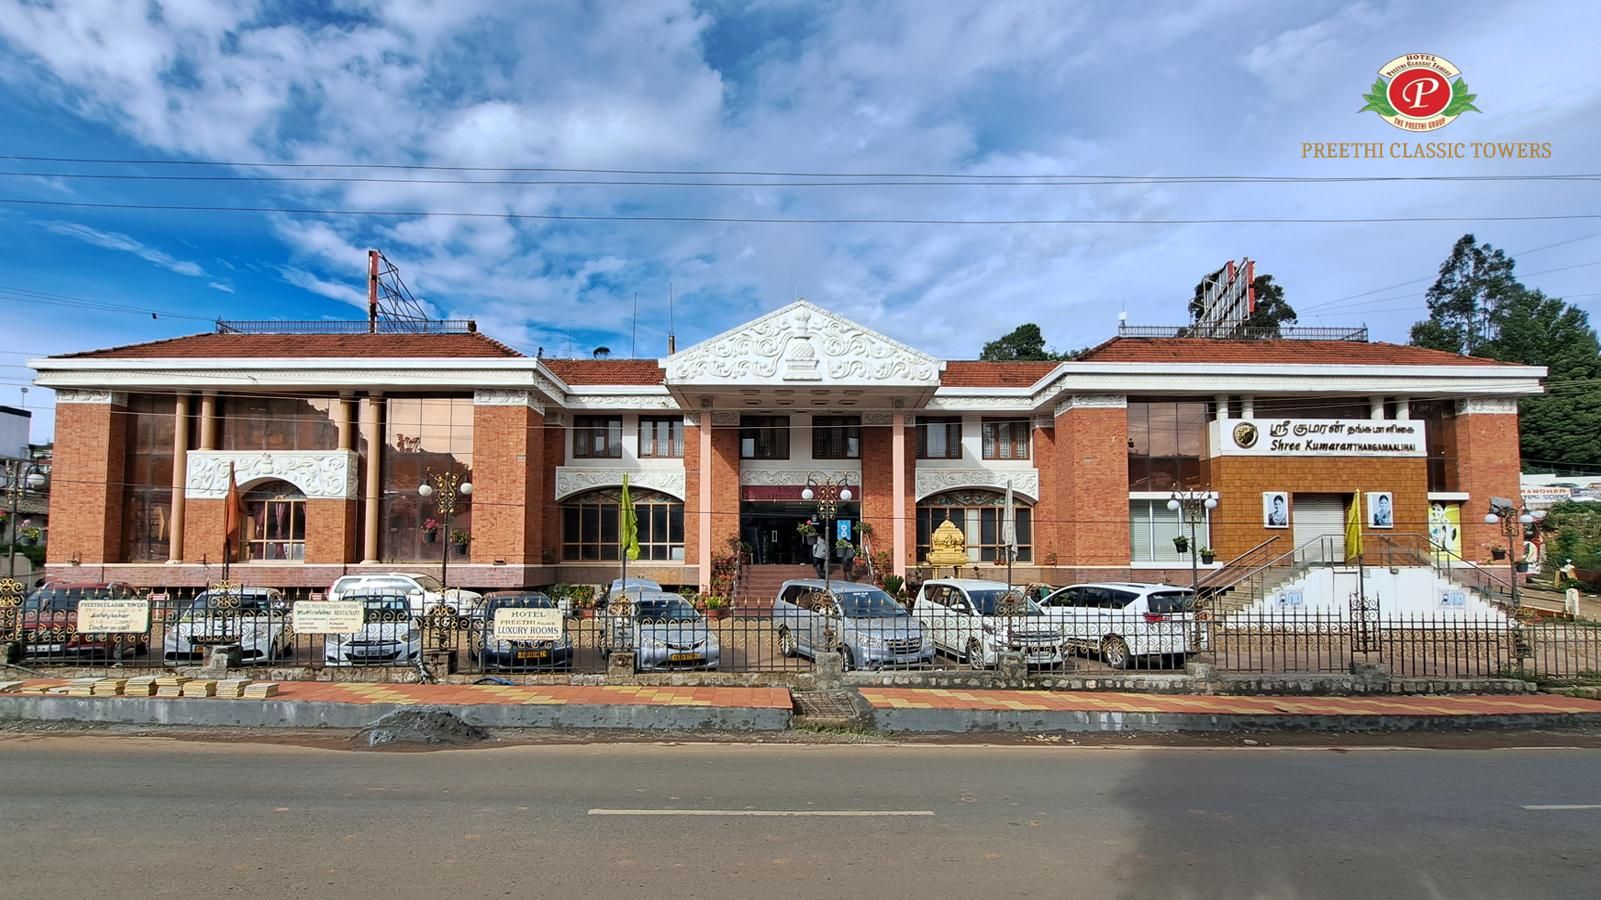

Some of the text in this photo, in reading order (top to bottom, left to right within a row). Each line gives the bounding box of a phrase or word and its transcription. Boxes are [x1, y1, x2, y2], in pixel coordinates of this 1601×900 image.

[1293, 421, 1345, 436] குமரன்
[1270, 439, 1301, 451] Shree
[1305, 440, 1353, 451] Kumaran
